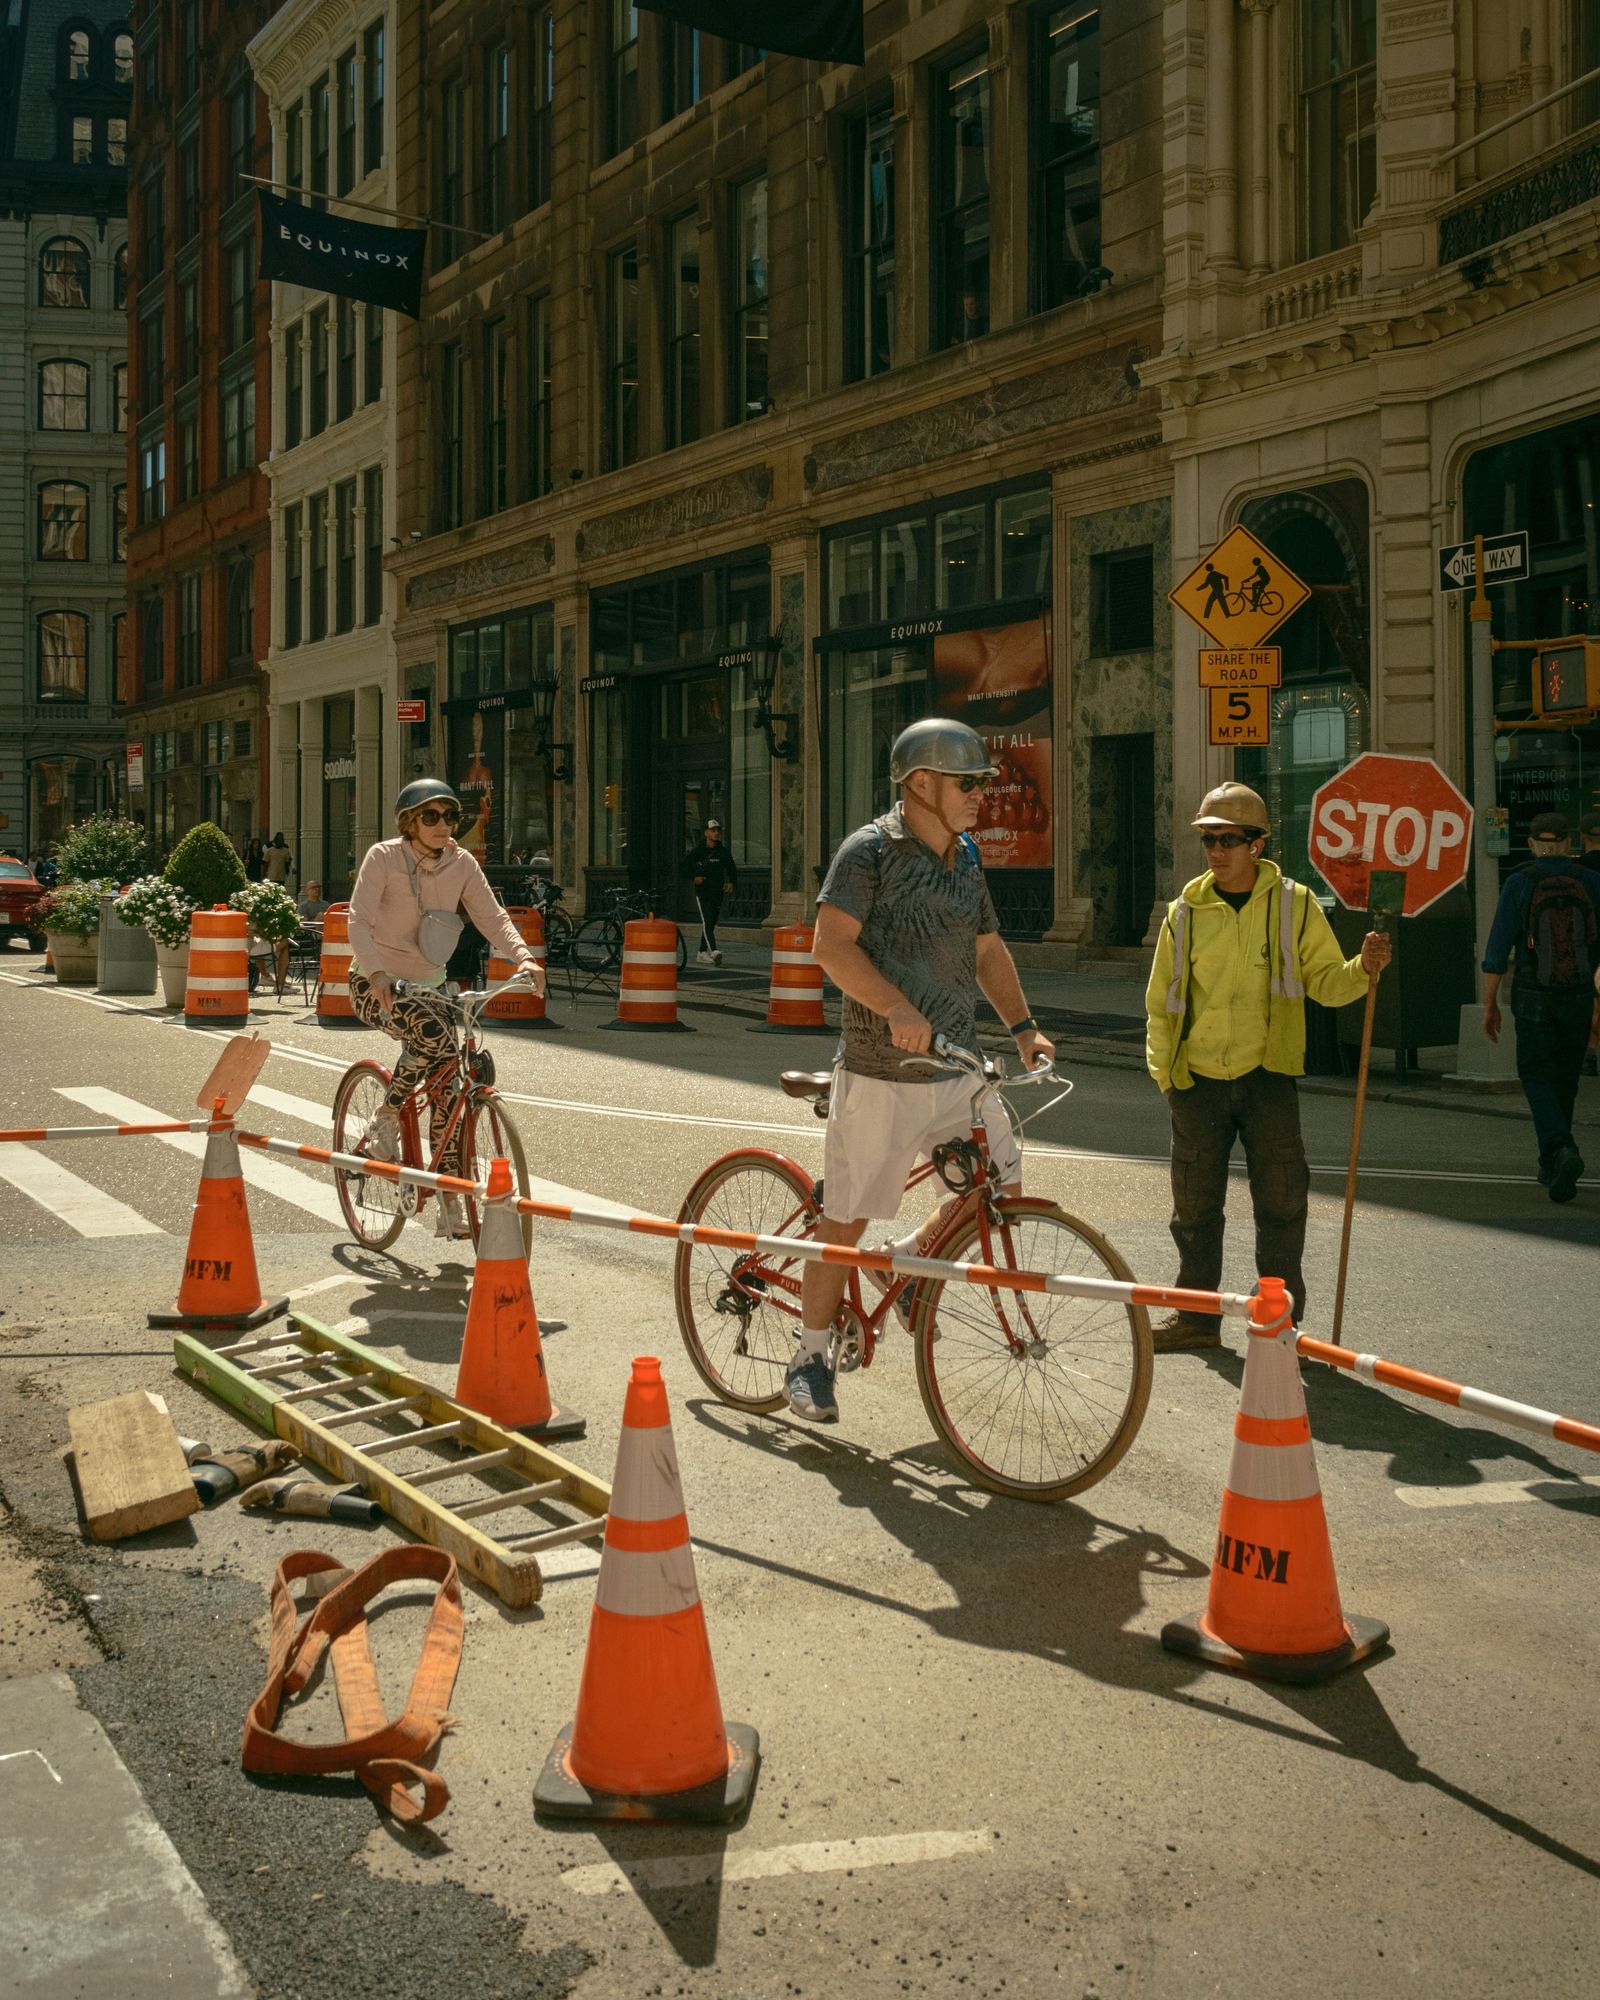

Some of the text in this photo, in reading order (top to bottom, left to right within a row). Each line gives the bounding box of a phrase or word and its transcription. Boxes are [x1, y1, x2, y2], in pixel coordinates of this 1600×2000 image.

[280, 224, 409, 270] EQUINOX
[1453, 548, 1516, 576] ONE WAY
[891, 620, 944, 640] EQUINOX
[719, 651, 753, 668] EQUINO
[1208, 653, 1270, 666] SHARE THE
[1220, 669, 1258, 681] ROAD
[583, 676, 615, 691] EQUINOX
[479, 696, 505, 710] EQUINOX
[968, 689, 1018, 702] WANT INTENSITY
[1227, 692, 1252, 721] 5
[994, 735, 1005, 750] IT
[1010, 732, 1034, 749] ALL
[1218, 727, 1261, 739] M.P.H.
[1512, 769, 1567, 785] INTERIOR
[1511, 788, 1570, 804] PLANNING
[1316, 798, 1465, 871] STOP
